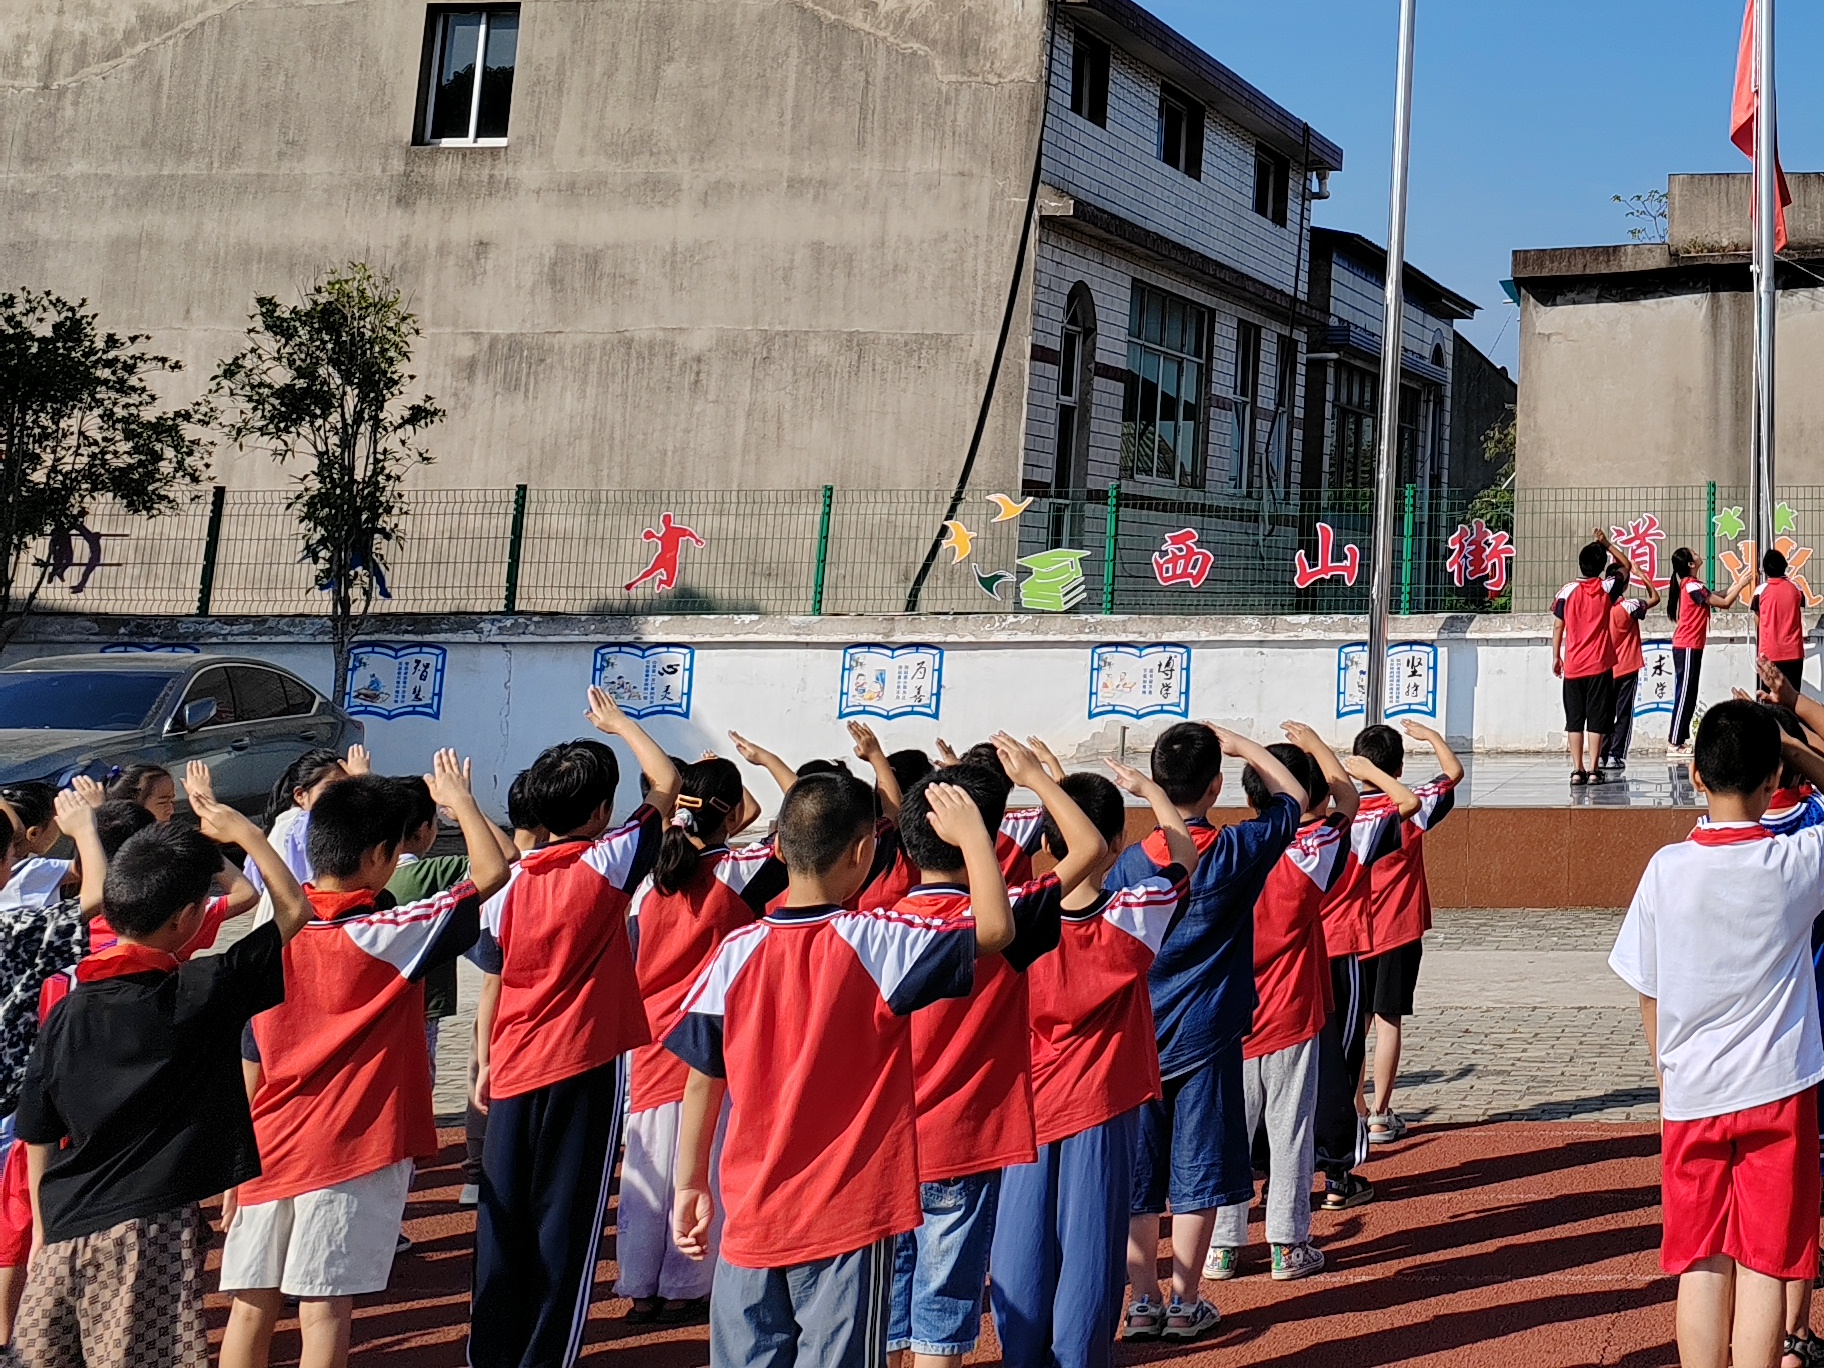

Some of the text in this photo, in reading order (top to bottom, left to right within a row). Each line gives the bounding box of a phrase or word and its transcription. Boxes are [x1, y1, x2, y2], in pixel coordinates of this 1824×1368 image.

[1152, 512, 1671, 592] 西山街道
[411, 659, 431, 702] 智慧
[657, 663, 681, 701] 心灵
[909, 660, 927, 703] 为善
[1157, 654, 1176, 699] 博学
[1404, 655, 1423, 698] 坚持
[1651, 654, 1673, 699] 求学
